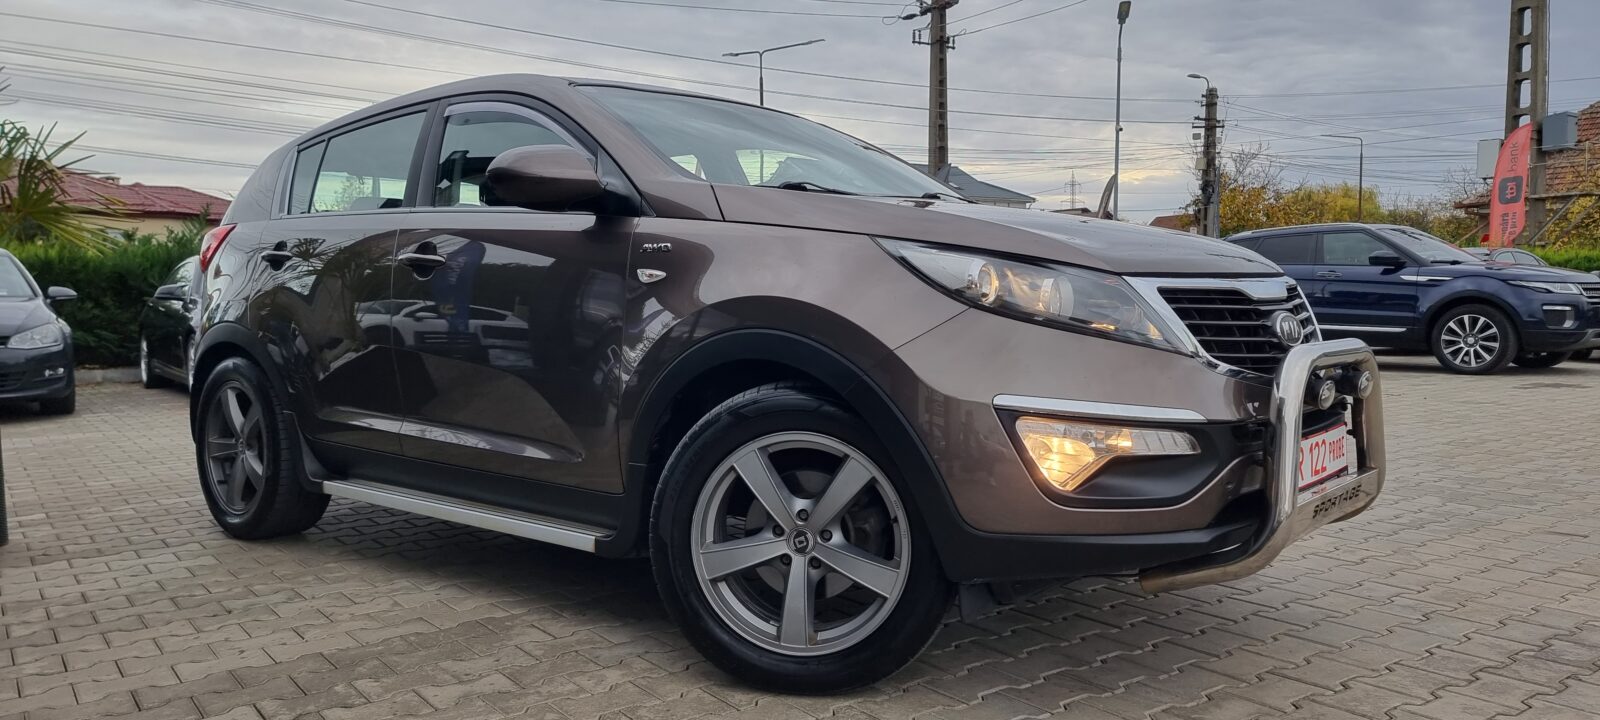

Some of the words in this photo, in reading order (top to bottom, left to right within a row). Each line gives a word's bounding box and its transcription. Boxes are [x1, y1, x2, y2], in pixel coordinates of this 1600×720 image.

[1507, 142, 1519, 173] bank
[640, 243, 672, 252] AWD
[1309, 438, 1327, 477] 122
[1329, 436, 1345, 464] PROBE
[1312, 484, 1362, 519] SPORTAGE
